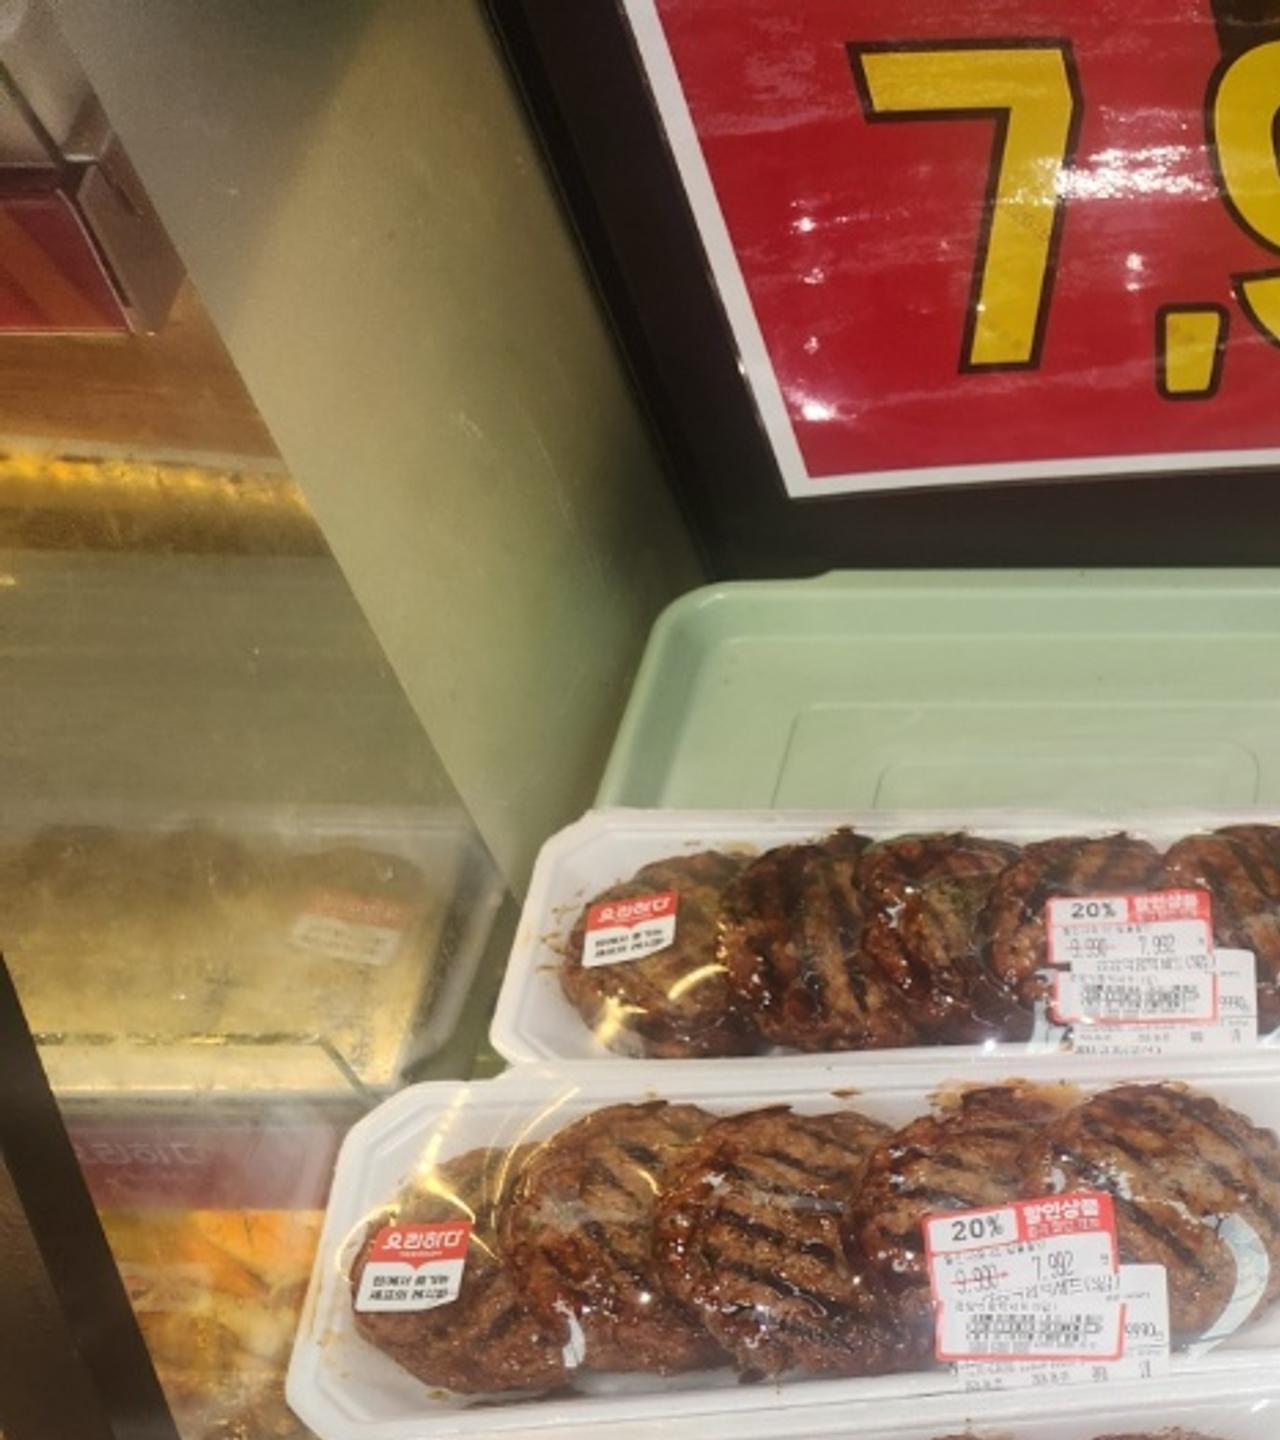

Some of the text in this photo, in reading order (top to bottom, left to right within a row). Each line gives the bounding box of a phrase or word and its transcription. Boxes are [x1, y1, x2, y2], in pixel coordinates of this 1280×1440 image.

[1071, 902, 1117, 918] 20%
[1023, 1198, 1099, 1225] 할인상품
[382, 1229, 465, 1250] 요리하다
[951, 1215, 1004, 1242] 20%
